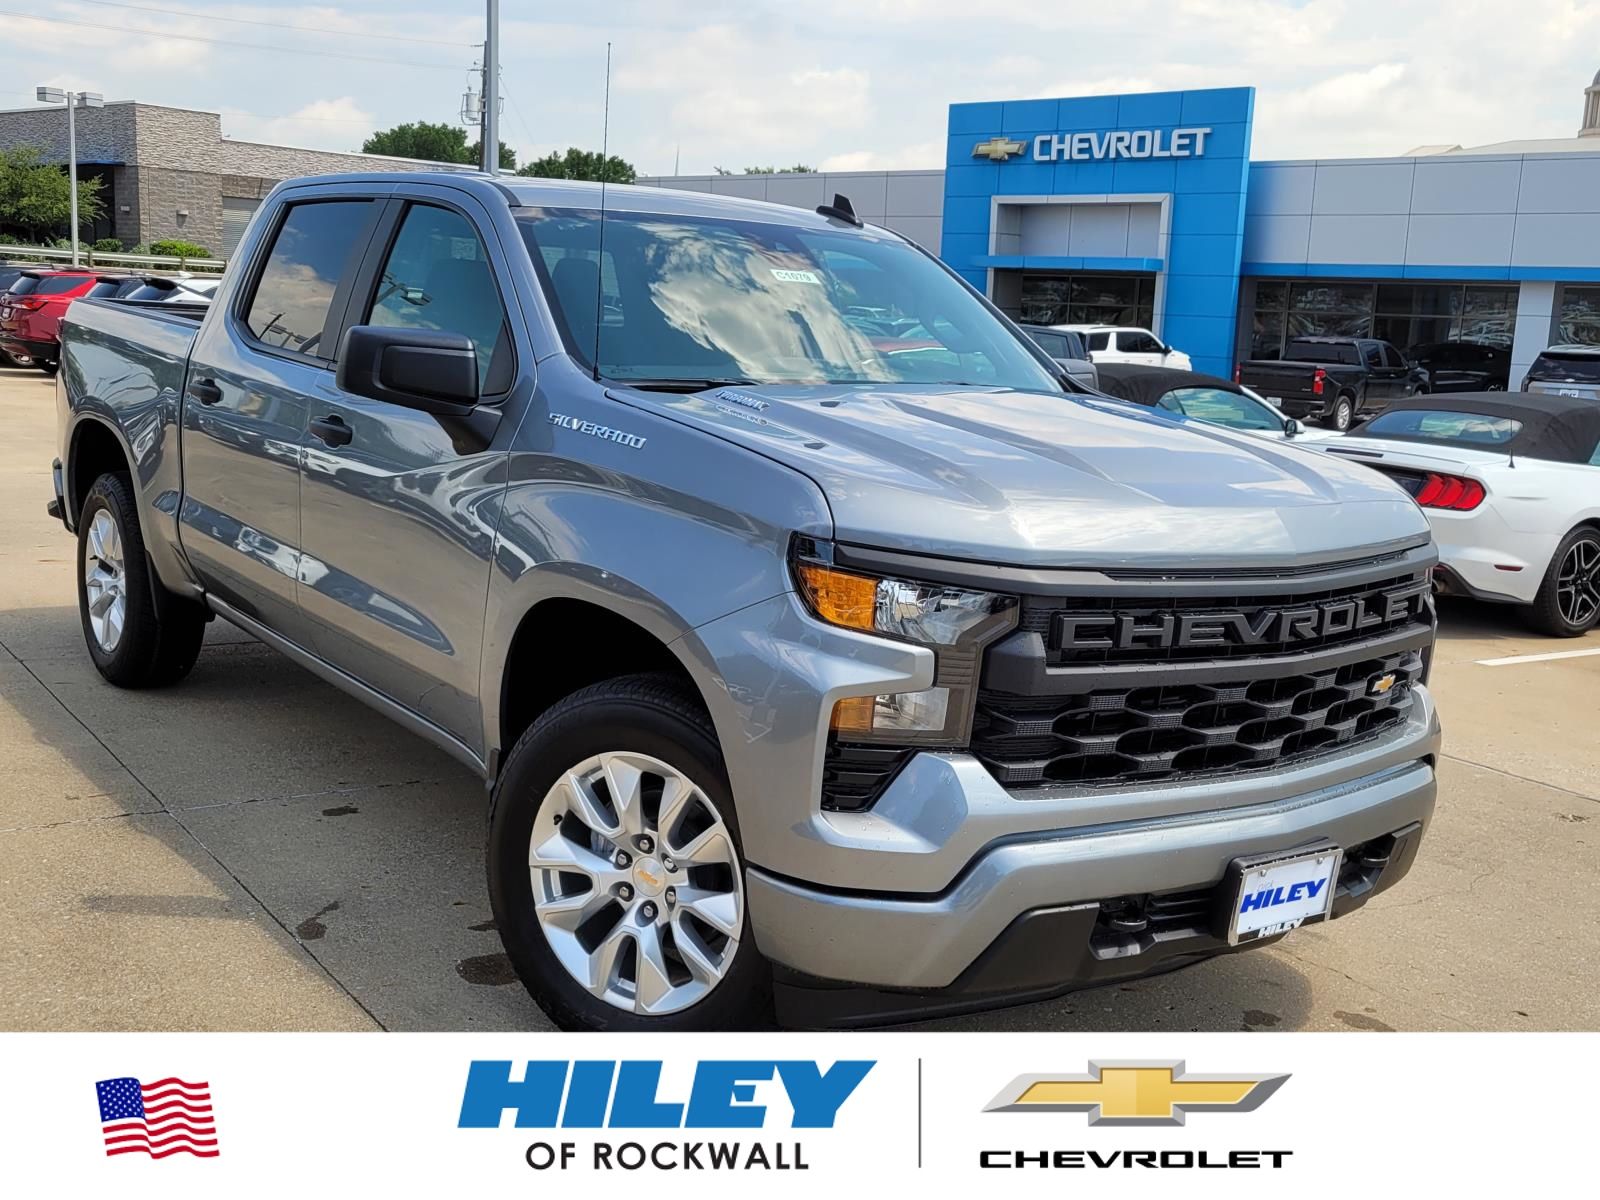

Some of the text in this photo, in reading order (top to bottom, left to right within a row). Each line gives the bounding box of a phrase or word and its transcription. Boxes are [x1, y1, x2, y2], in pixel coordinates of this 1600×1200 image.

[1033, 127, 1213, 162] CHEVROLET
[547, 412, 648, 449] SILVERADO
[1240, 878, 1327, 914] HILEY
[1257, 917, 1305, 938] HILEY
